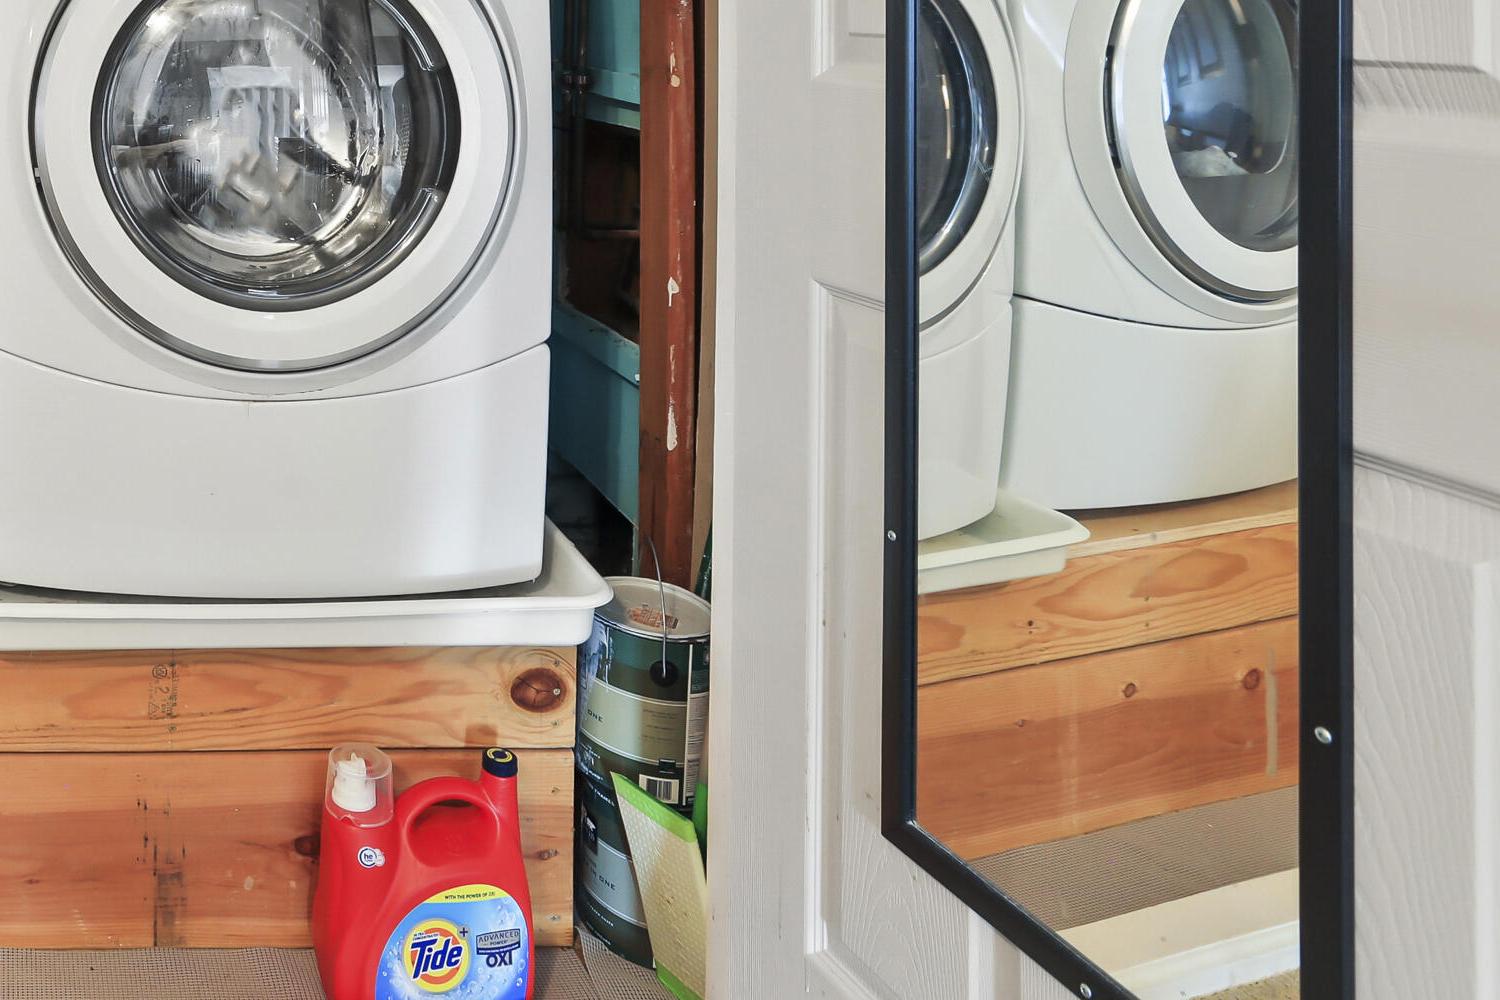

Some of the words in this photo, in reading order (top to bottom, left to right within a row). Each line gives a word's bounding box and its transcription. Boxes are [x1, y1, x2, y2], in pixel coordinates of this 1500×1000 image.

[598, 874, 617, 889] ONE
[478, 930, 520, 944] ADVANCED
[410, 937, 463, 980] Tide
[486, 951, 513, 968] OXI
